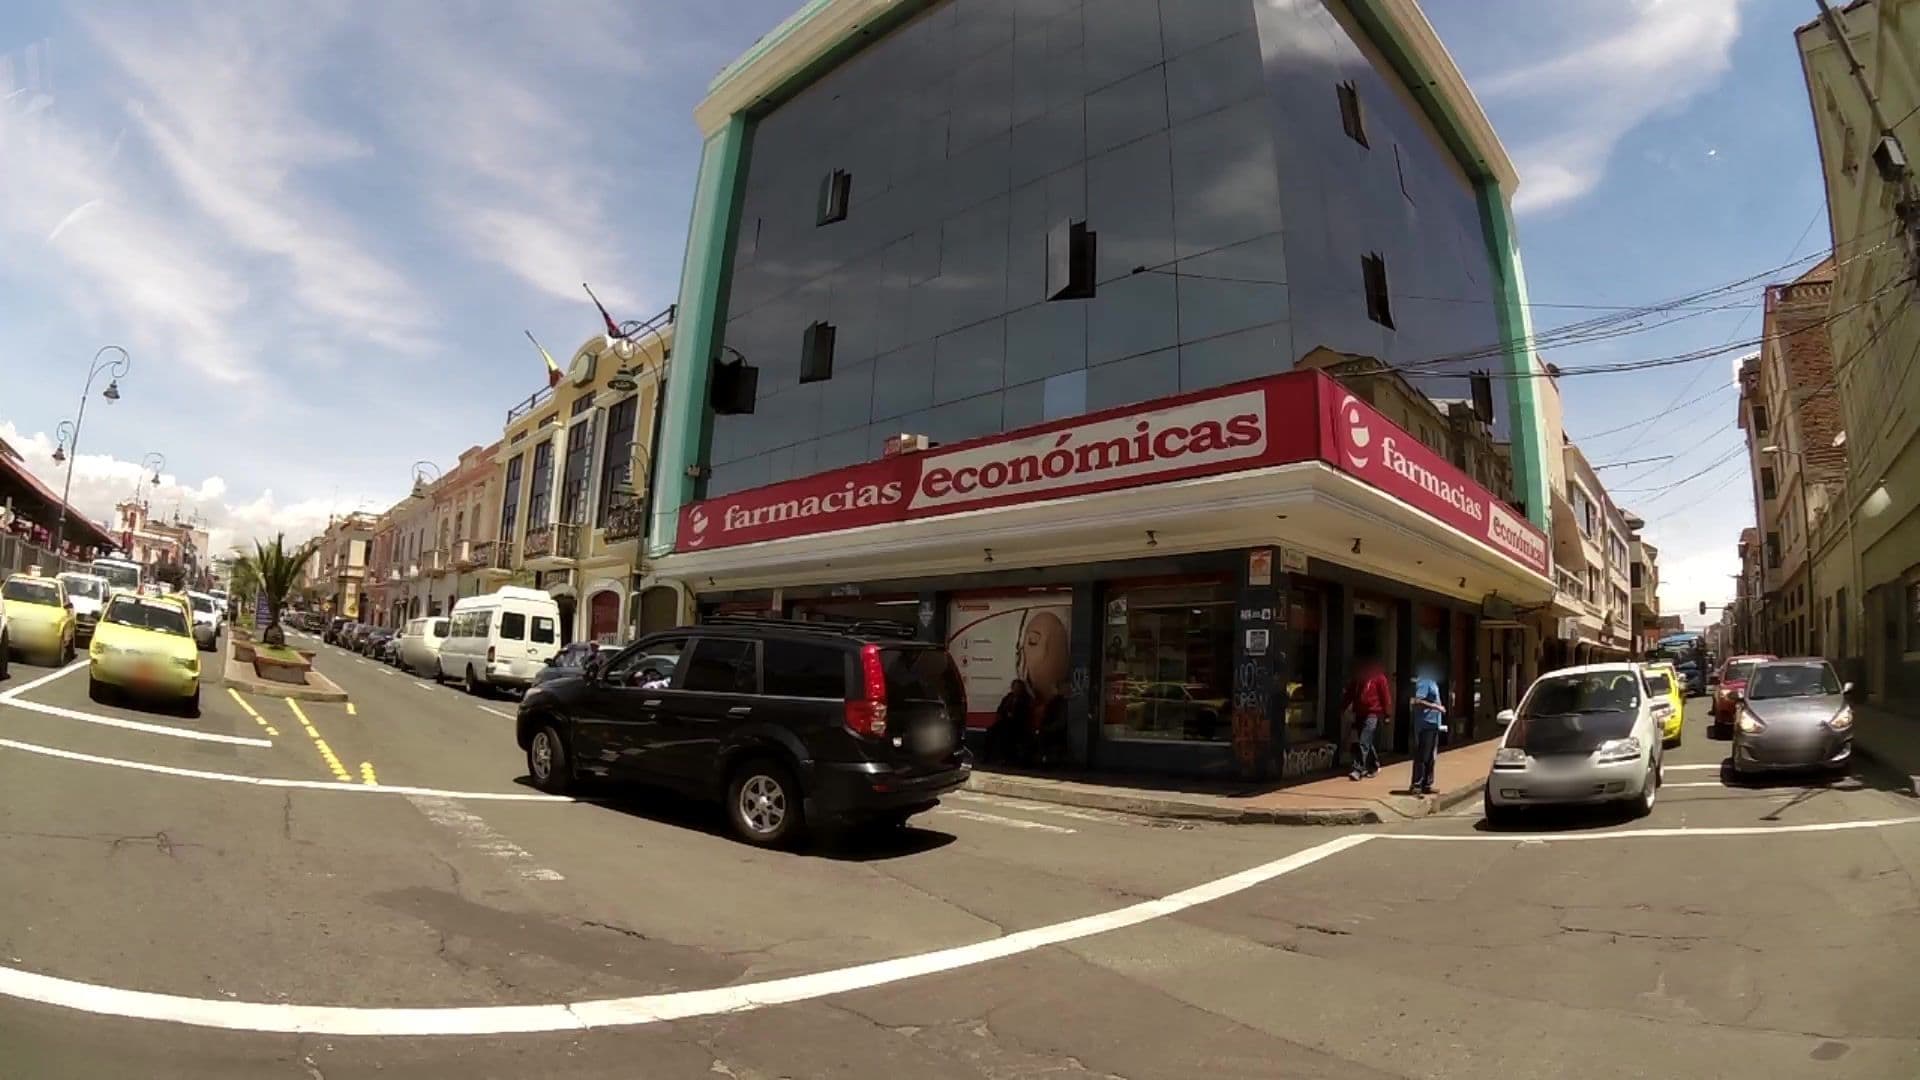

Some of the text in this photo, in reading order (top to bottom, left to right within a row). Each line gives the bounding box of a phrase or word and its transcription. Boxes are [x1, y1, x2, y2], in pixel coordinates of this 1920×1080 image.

[722, 413, 1263, 532] farmacias económicas
[1381, 436, 1483, 521] farmacias
